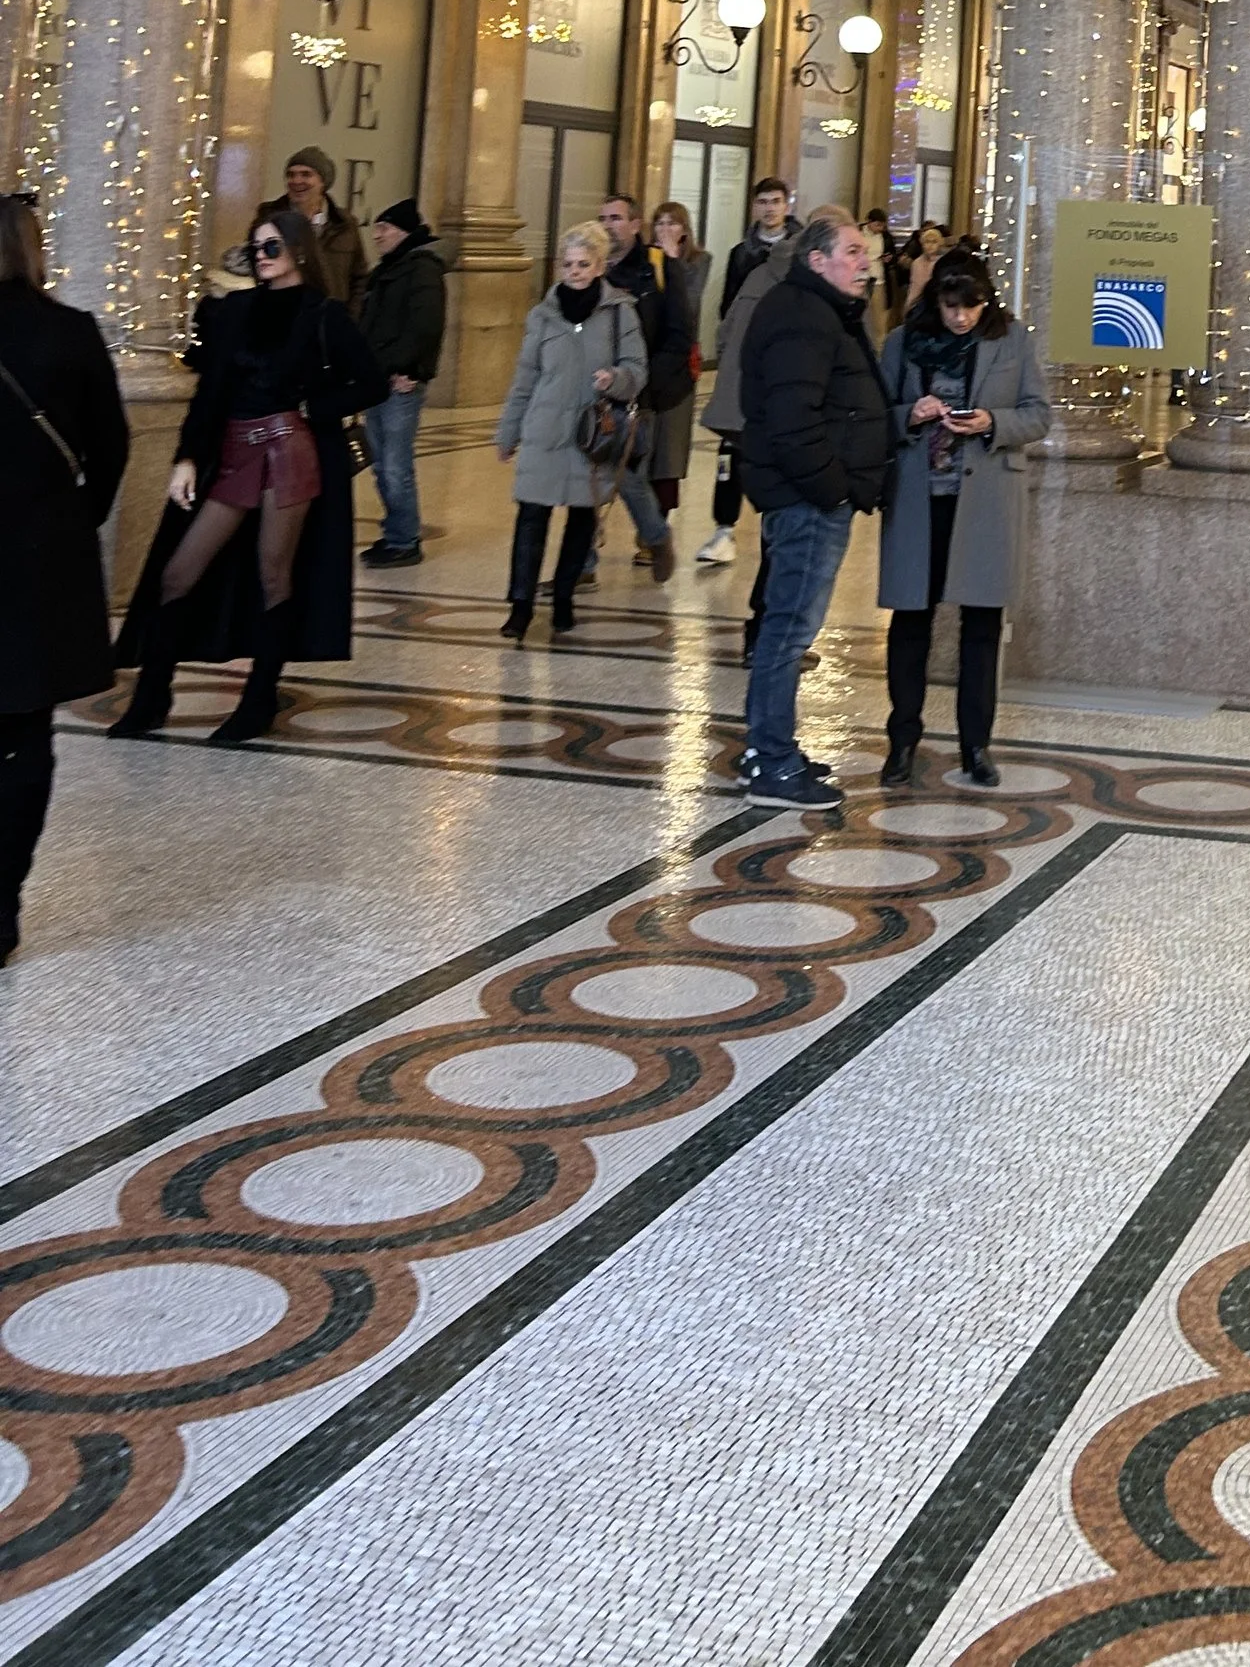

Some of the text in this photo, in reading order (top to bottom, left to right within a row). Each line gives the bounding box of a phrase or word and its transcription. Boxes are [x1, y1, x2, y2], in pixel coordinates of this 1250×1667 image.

[314, 59, 382, 130] VE
[1087, 229, 1179, 243] FONDO MEGAS
[1096, 281, 1165, 293] ENASARCO
